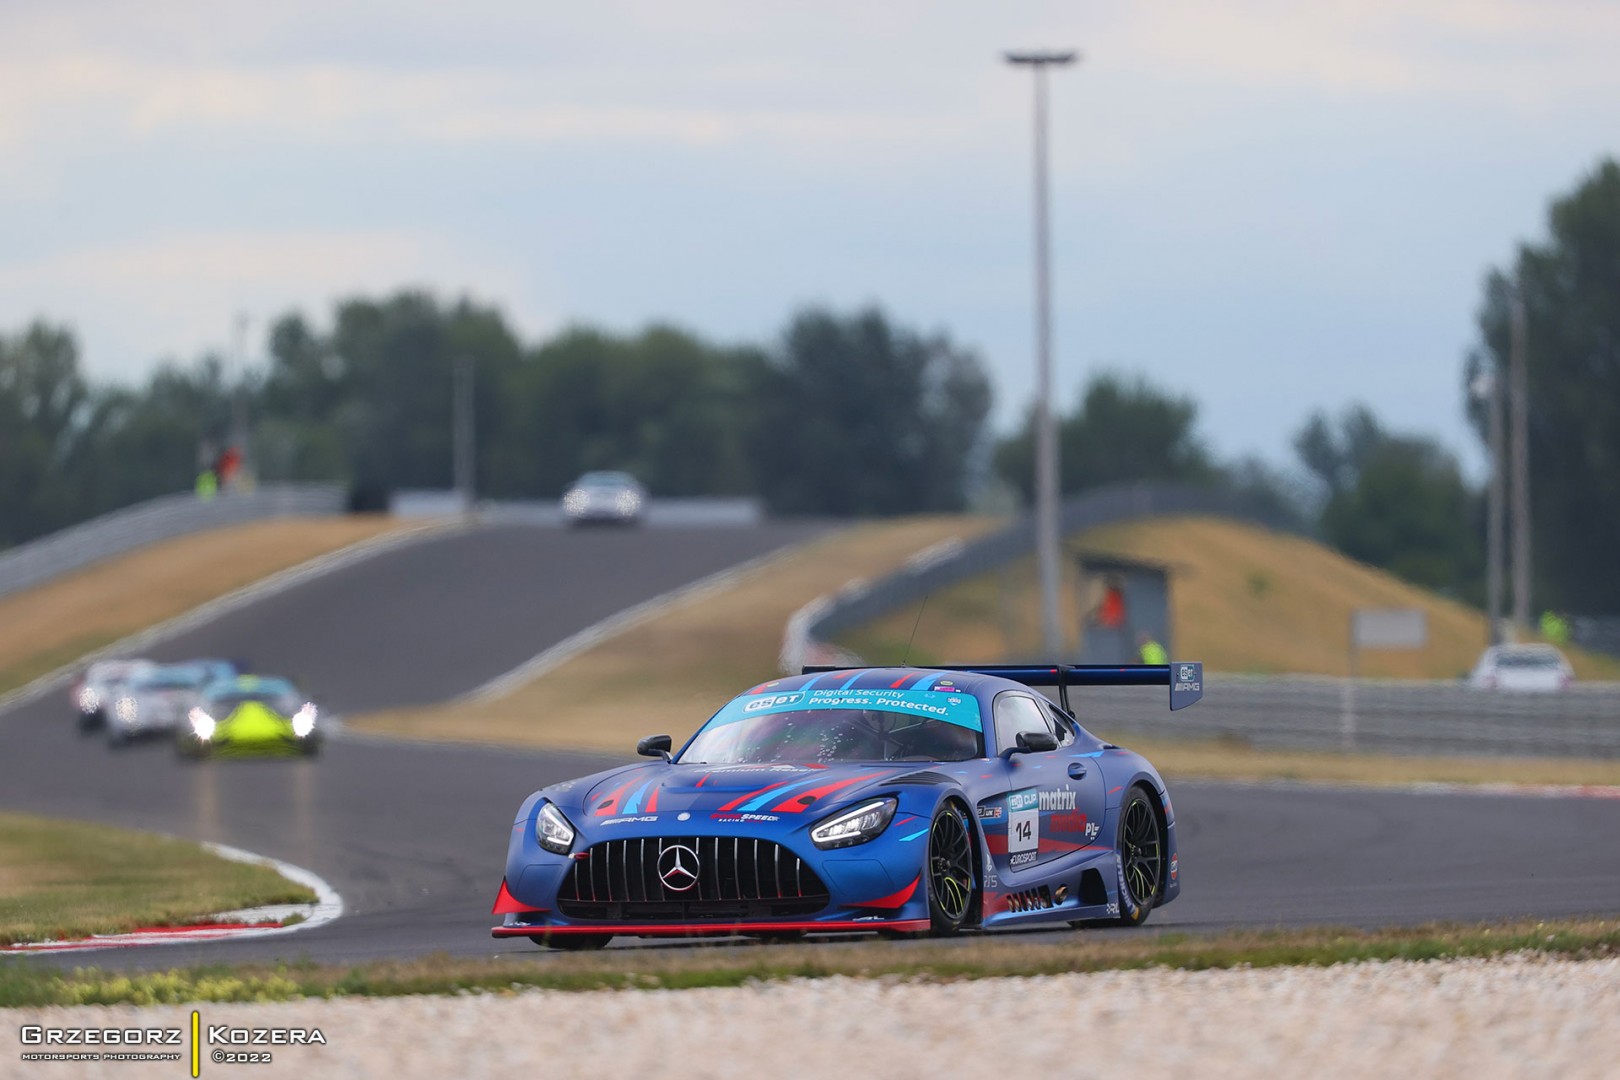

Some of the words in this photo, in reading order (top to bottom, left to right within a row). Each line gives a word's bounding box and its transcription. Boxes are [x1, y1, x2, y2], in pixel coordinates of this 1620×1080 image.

[813, 689, 855, 697] Digital
[856, 689, 905, 699] Security
[808, 697, 872, 706] Progress.
[876, 698, 949, 715] Protected.
[1024, 793, 1037, 805] CUP
[1038, 784, 1077, 811] matrix
[1015, 820, 1031, 842] 14
